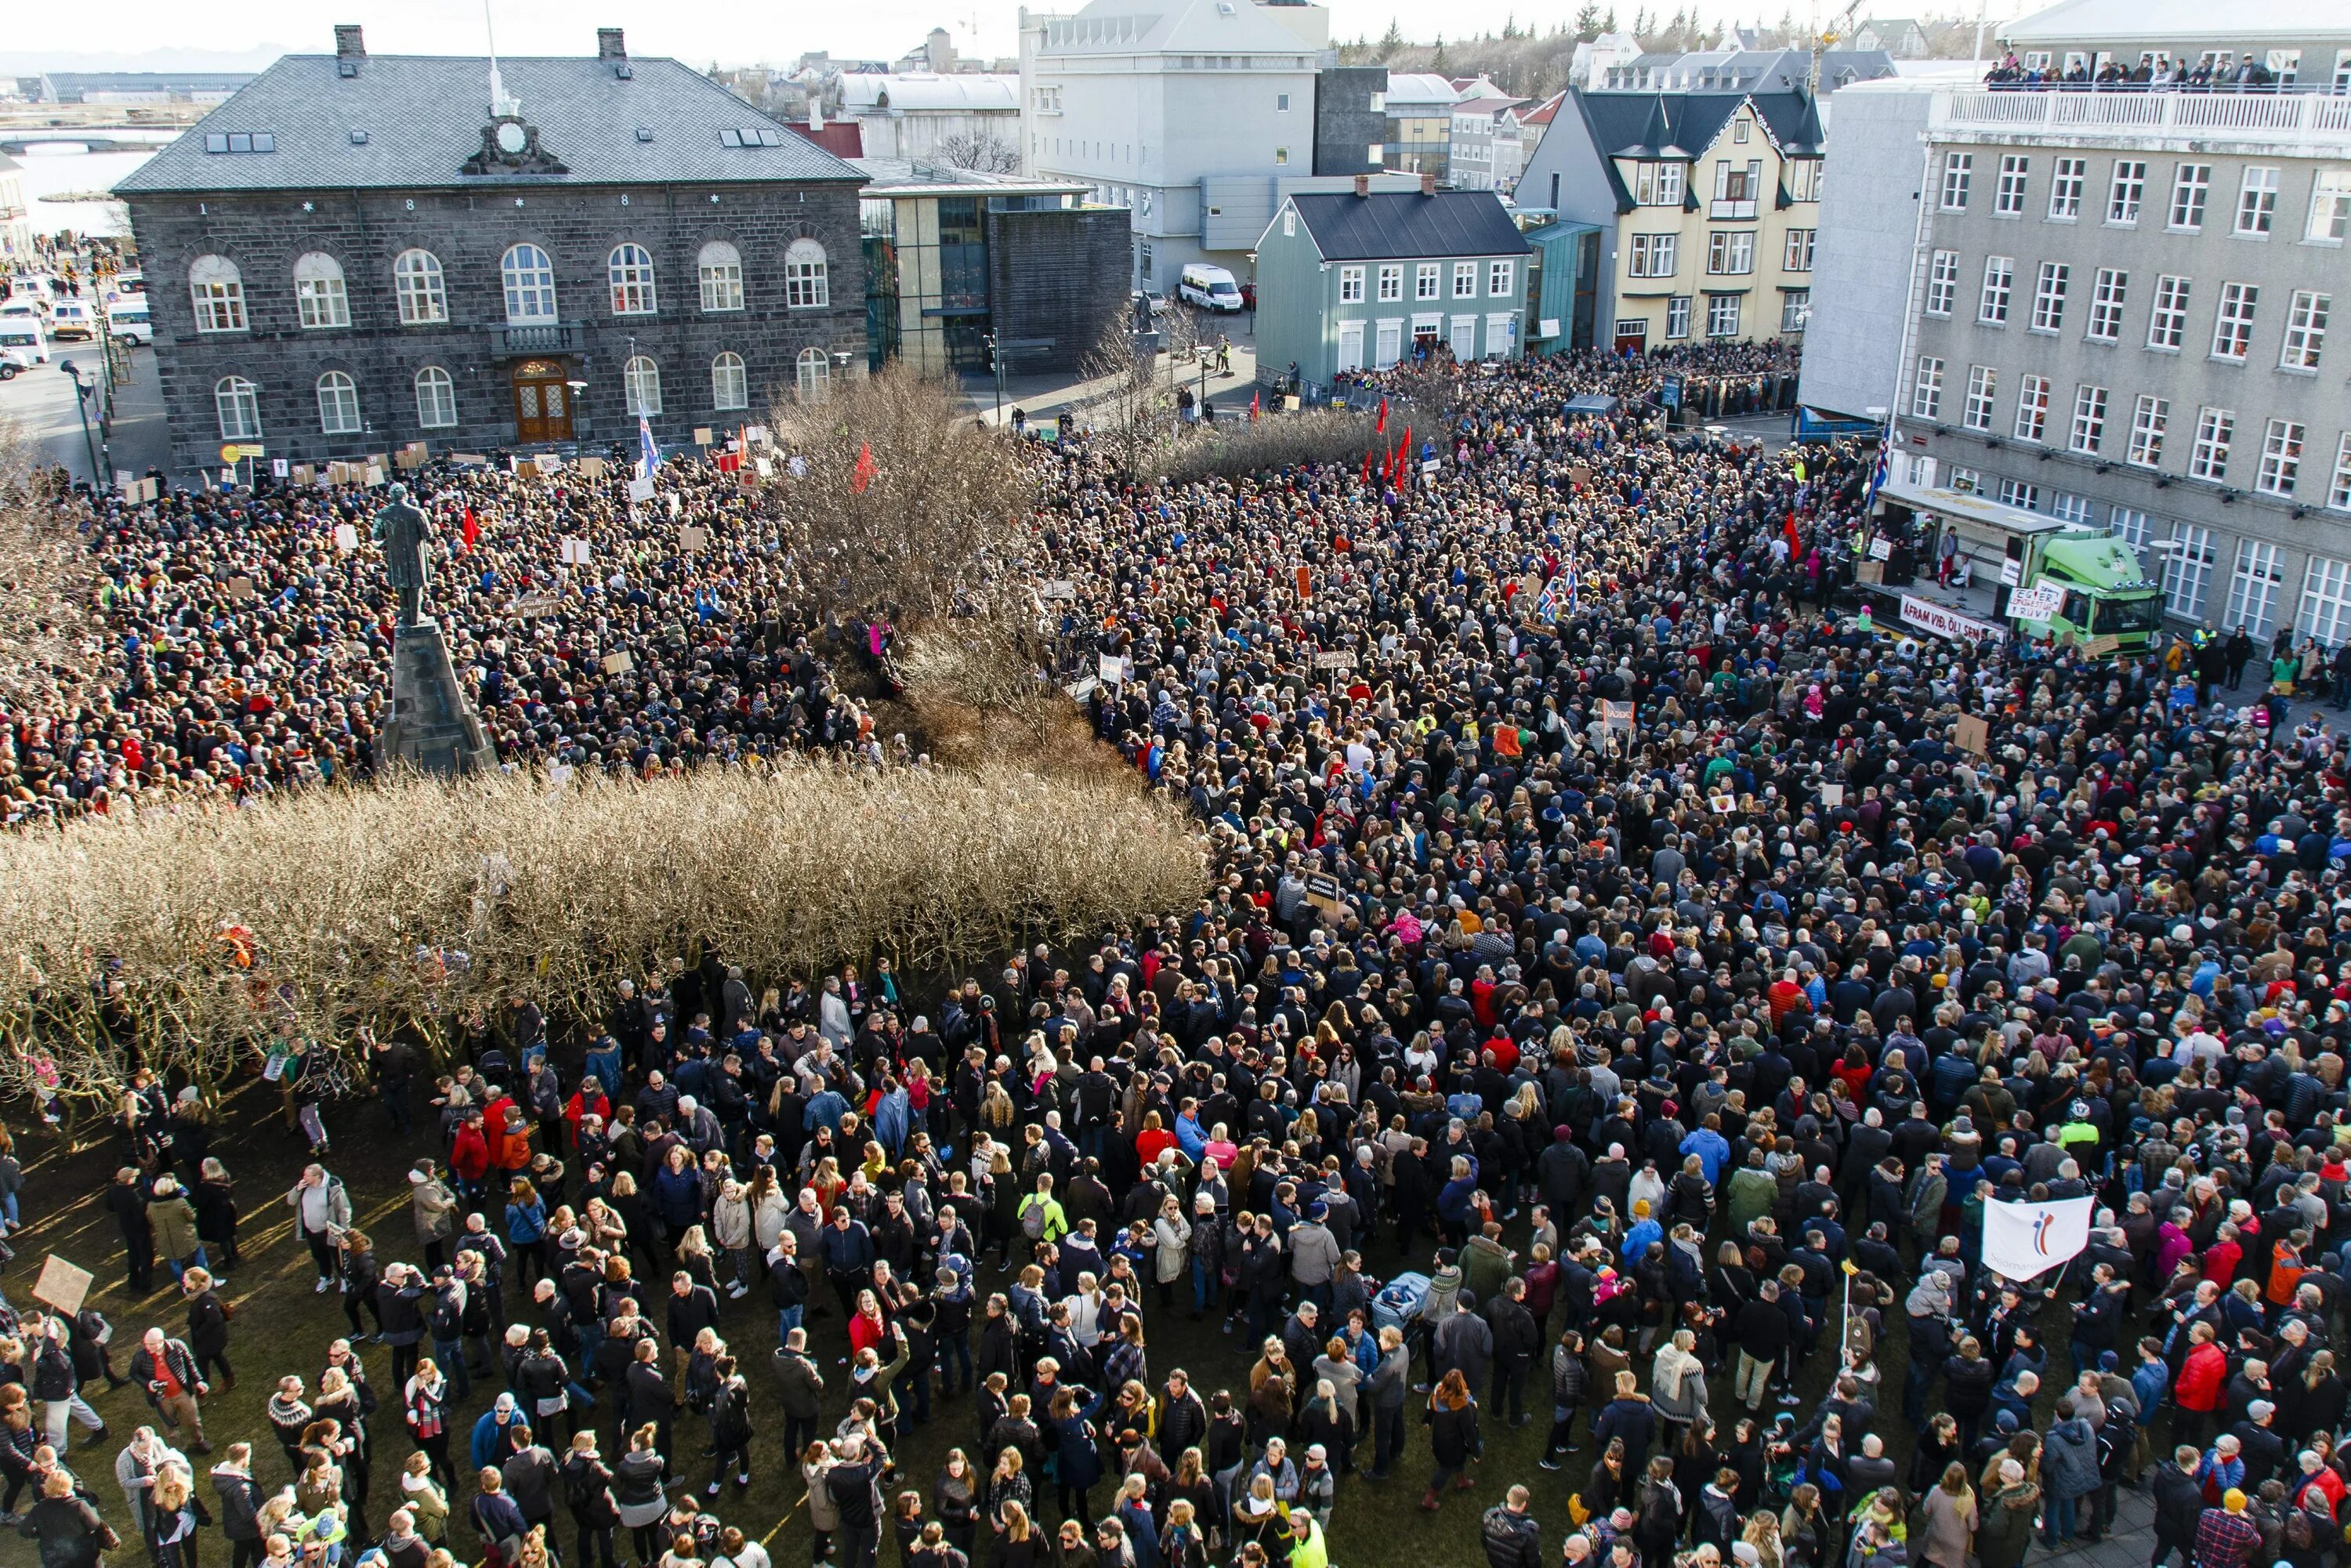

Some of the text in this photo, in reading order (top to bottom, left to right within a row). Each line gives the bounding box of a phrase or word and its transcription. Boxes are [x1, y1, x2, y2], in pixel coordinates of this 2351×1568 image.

[406, 199, 415, 210] 8
[621, 194, 629, 205] 8
[1904, 601, 1929, 624] ÁFRAM
